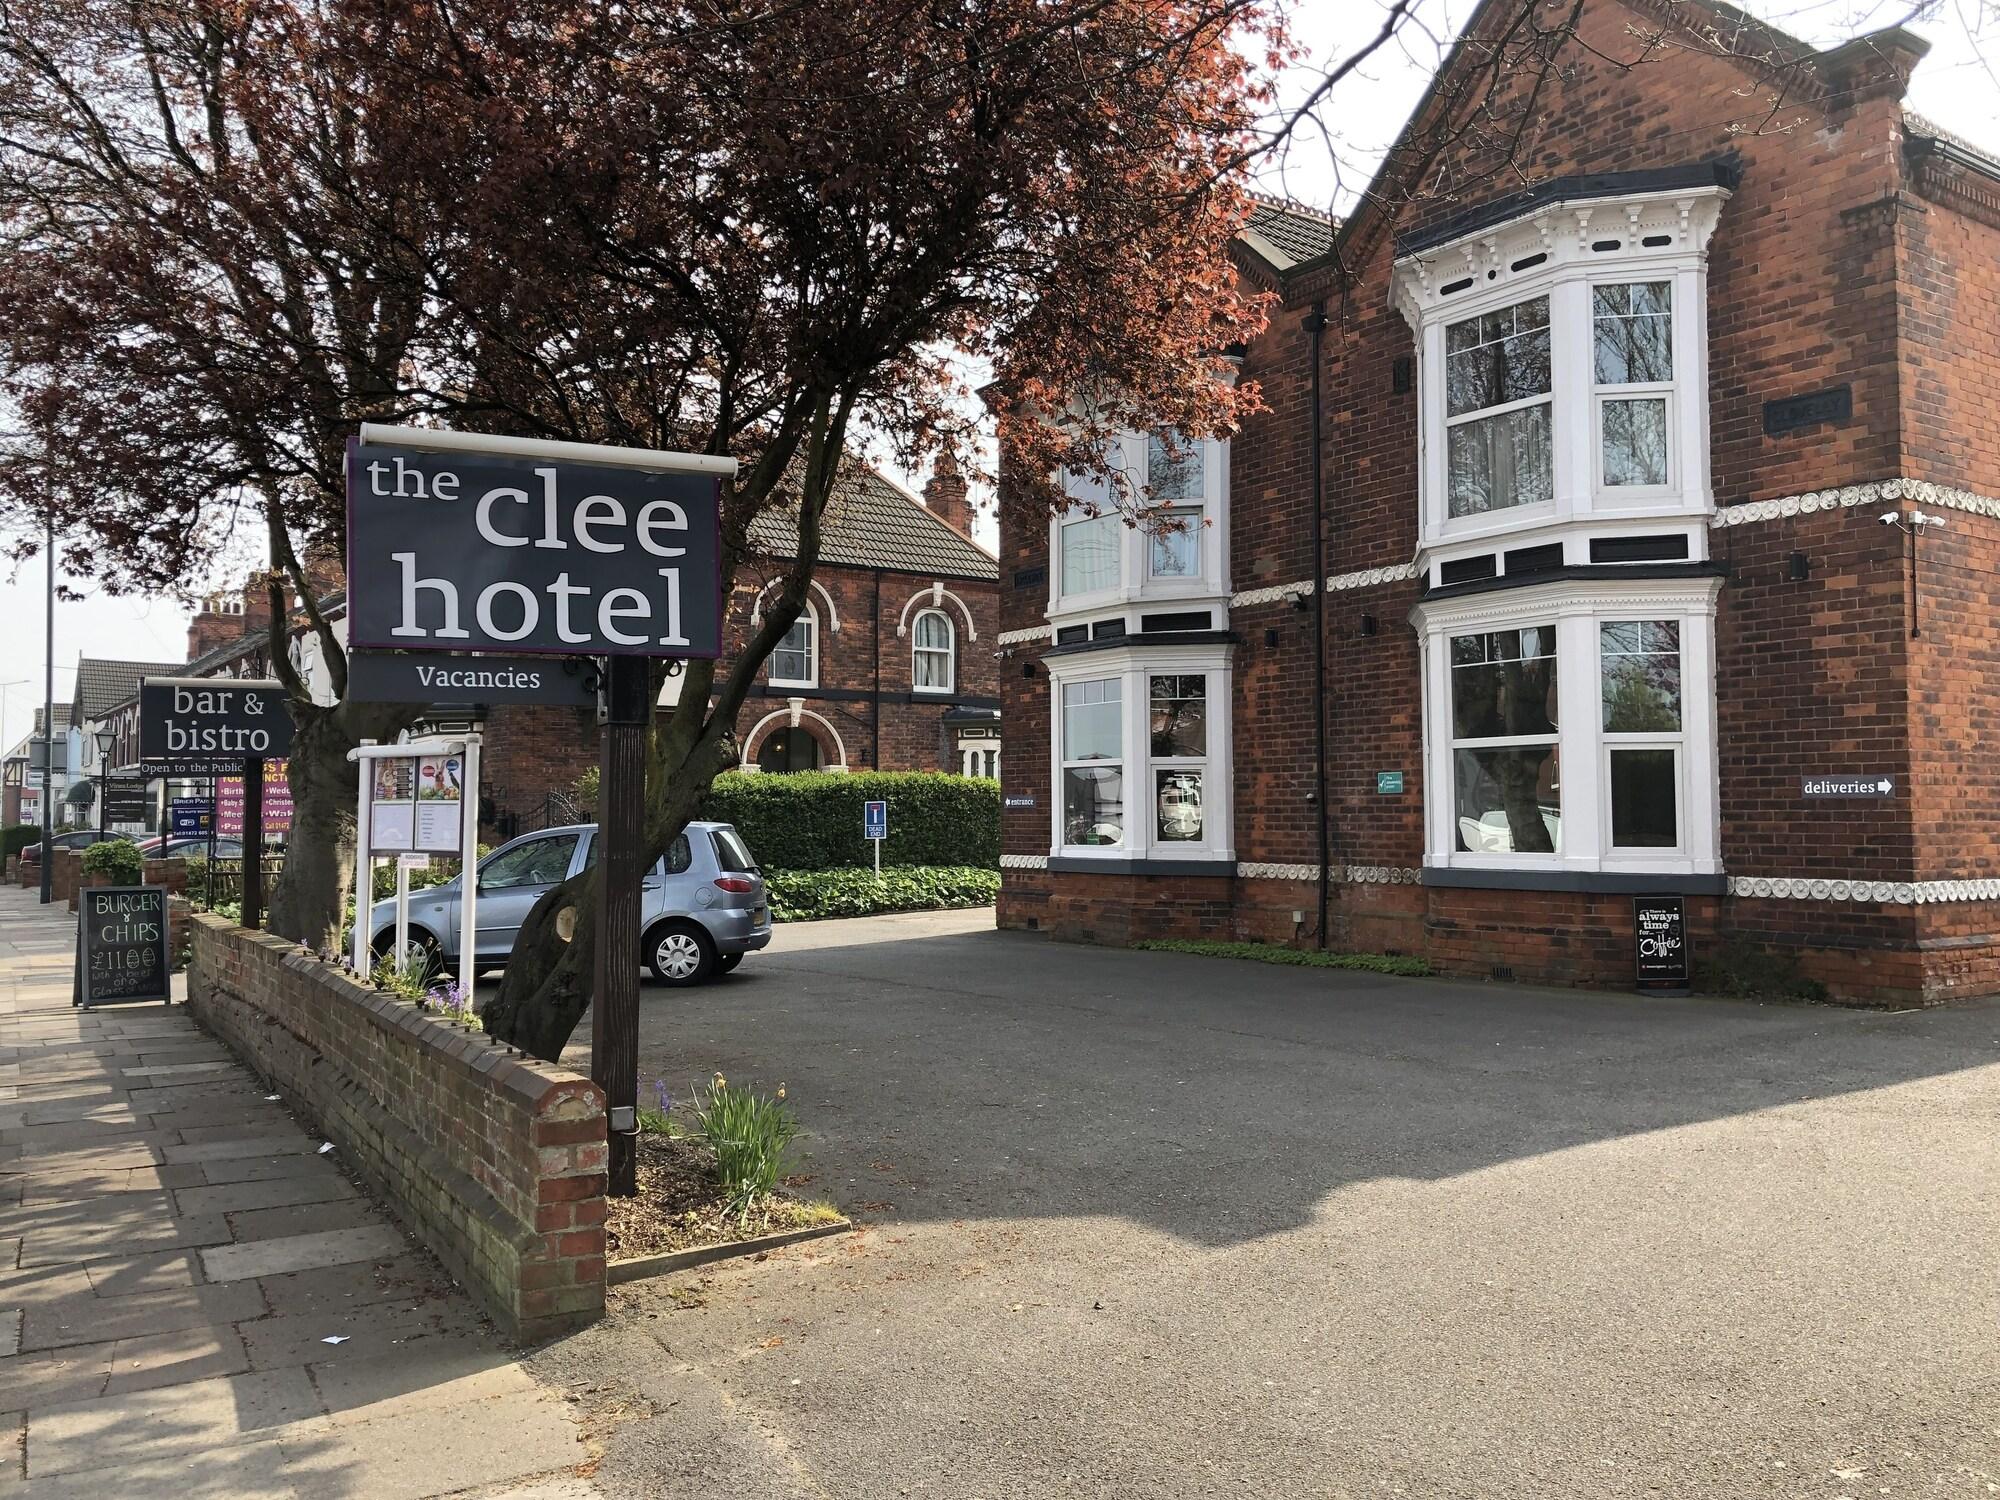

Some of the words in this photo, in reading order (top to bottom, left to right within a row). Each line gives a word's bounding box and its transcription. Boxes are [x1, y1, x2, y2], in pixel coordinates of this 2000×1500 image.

[366, 457, 460, 501] the
[475, 467, 689, 557] clee
[391, 552, 691, 646] hotel
[416, 666, 541, 689] Vacancies
[174, 685, 233, 714] bar
[244, 693, 264, 715] &
[164, 719, 270, 751] bistro
[141, 763, 170, 775] Open
[174, 764, 186, 773] to
[190, 763, 211, 773] the
[211, 763, 243, 773] Public
[223, 787, 244, 795] Birth
[1804, 780, 1875, 794] deliveries
[96, 893, 160, 914] BURGER
[1639, 912, 1679, 922] always
[1643, 921, 1669, 929] time
[101, 922, 160, 943] CHIPS
[1640, 933, 1681, 958] Coffee
